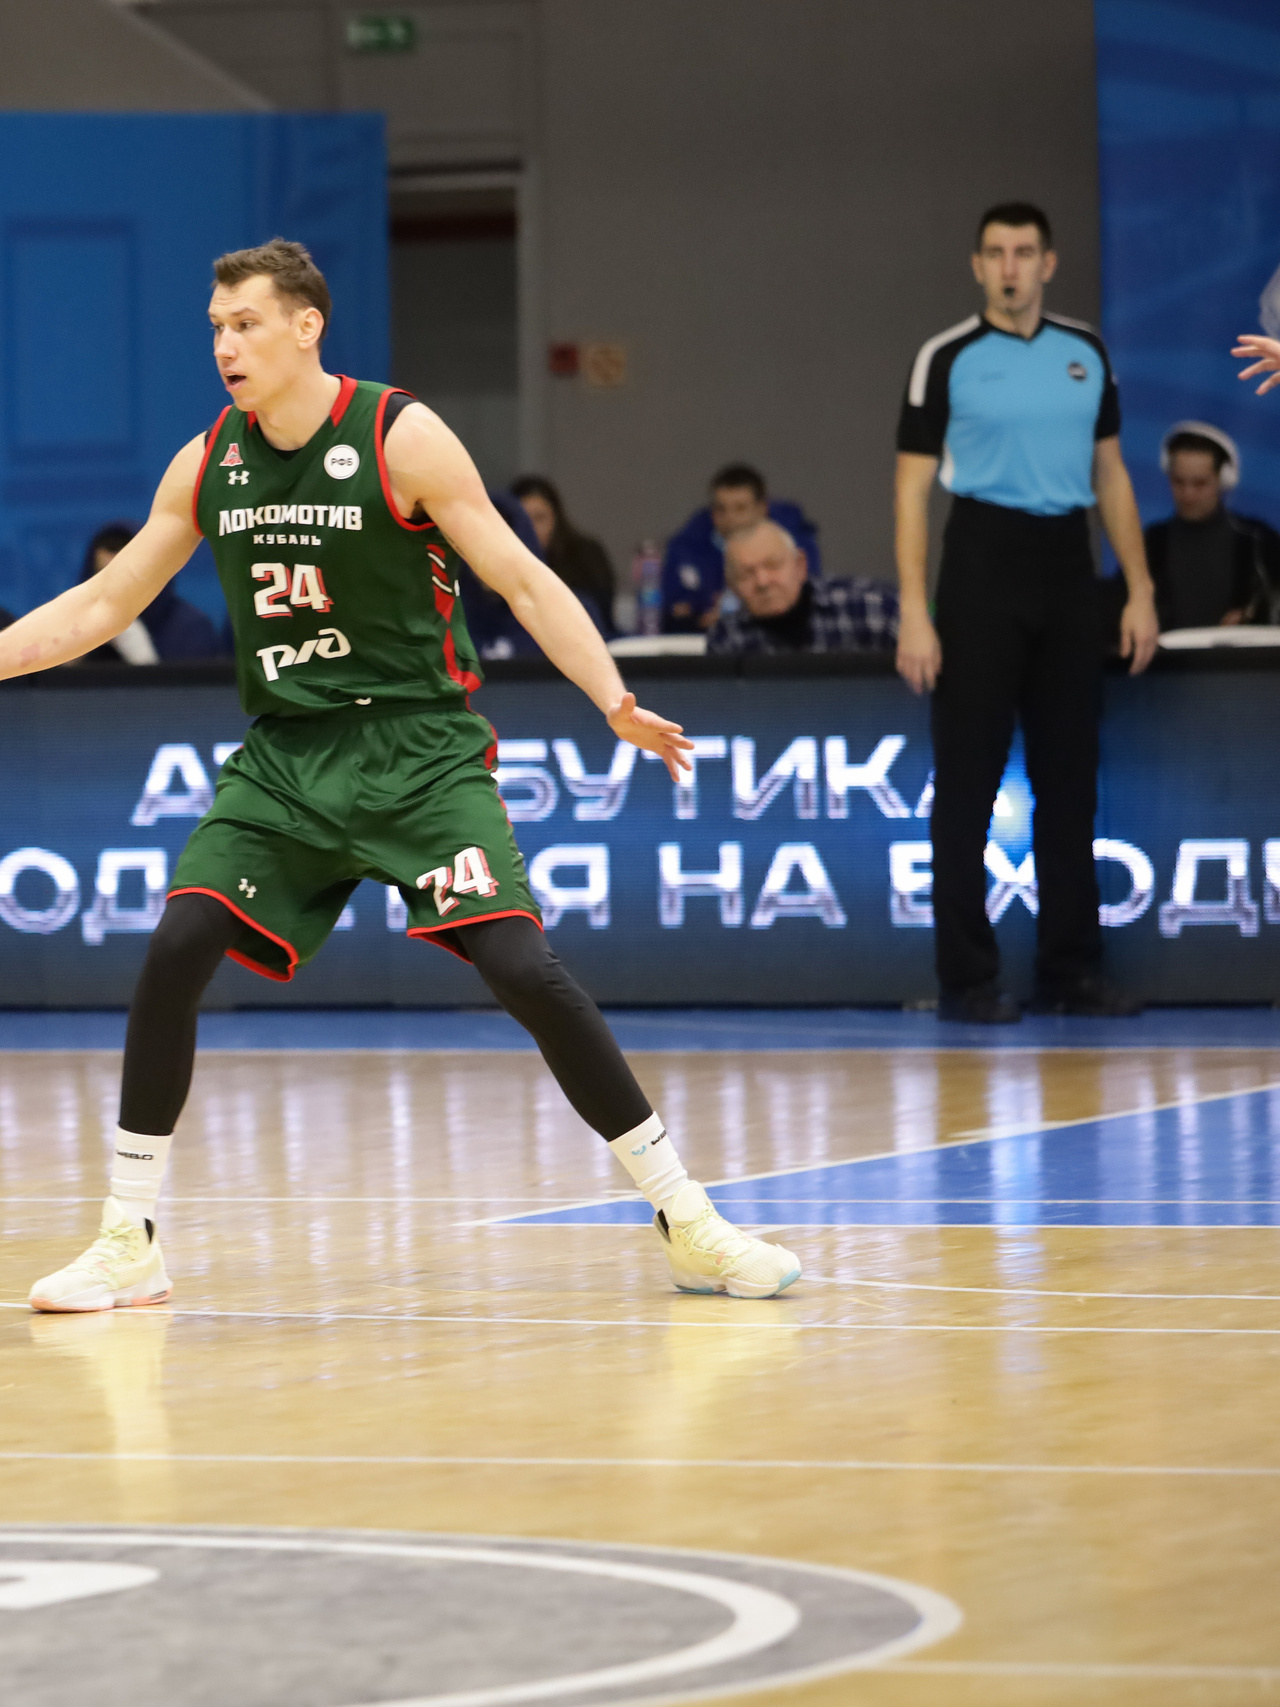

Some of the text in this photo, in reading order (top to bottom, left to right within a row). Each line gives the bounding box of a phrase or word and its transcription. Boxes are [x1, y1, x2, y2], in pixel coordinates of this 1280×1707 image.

[330, 457, 354, 467] РФБ
[218, 504, 363, 537] ЛОКОМОТИВ
[252, 533, 322, 546] КУБАНЬ
[250, 562, 335, 619] 24
[415, 846, 500, 917] 24
[658, 842, 848, 929] НА
